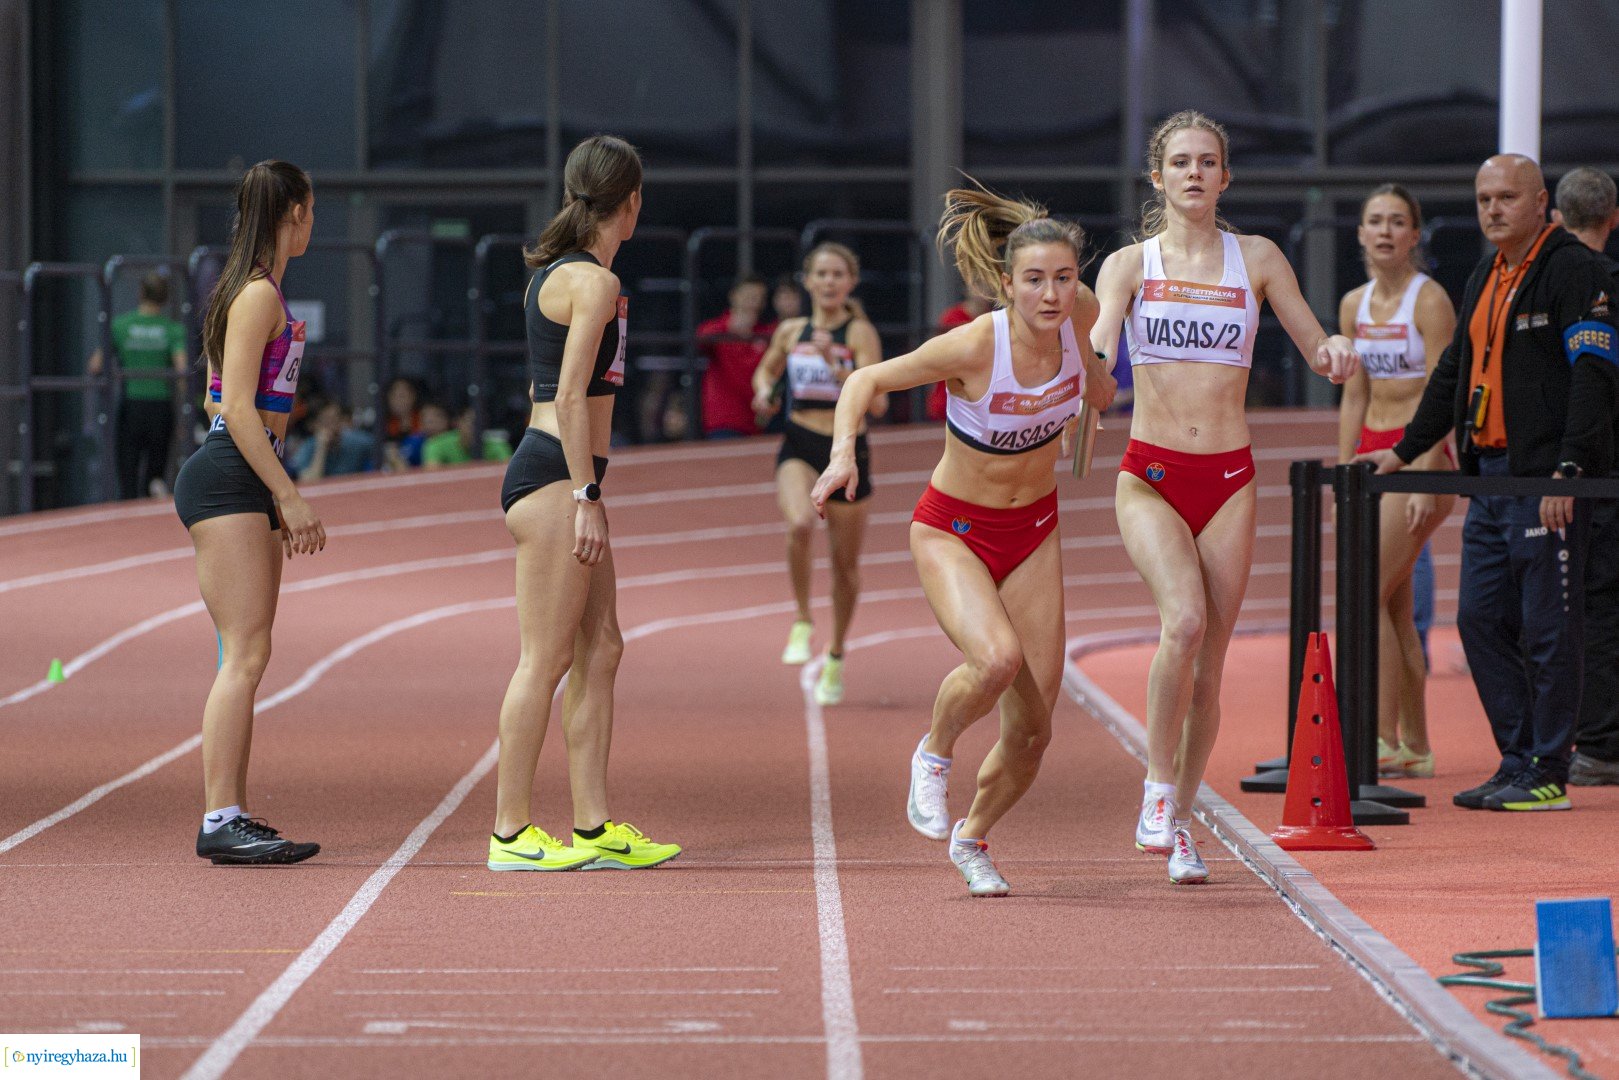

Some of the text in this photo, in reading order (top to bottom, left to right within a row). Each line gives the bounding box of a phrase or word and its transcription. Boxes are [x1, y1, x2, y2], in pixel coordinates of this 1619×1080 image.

[1146, 317, 1241, 350] VASAS/2
[1568, 330, 1611, 352] REFEREE
[1525, 526, 1548, 538] JAKO
